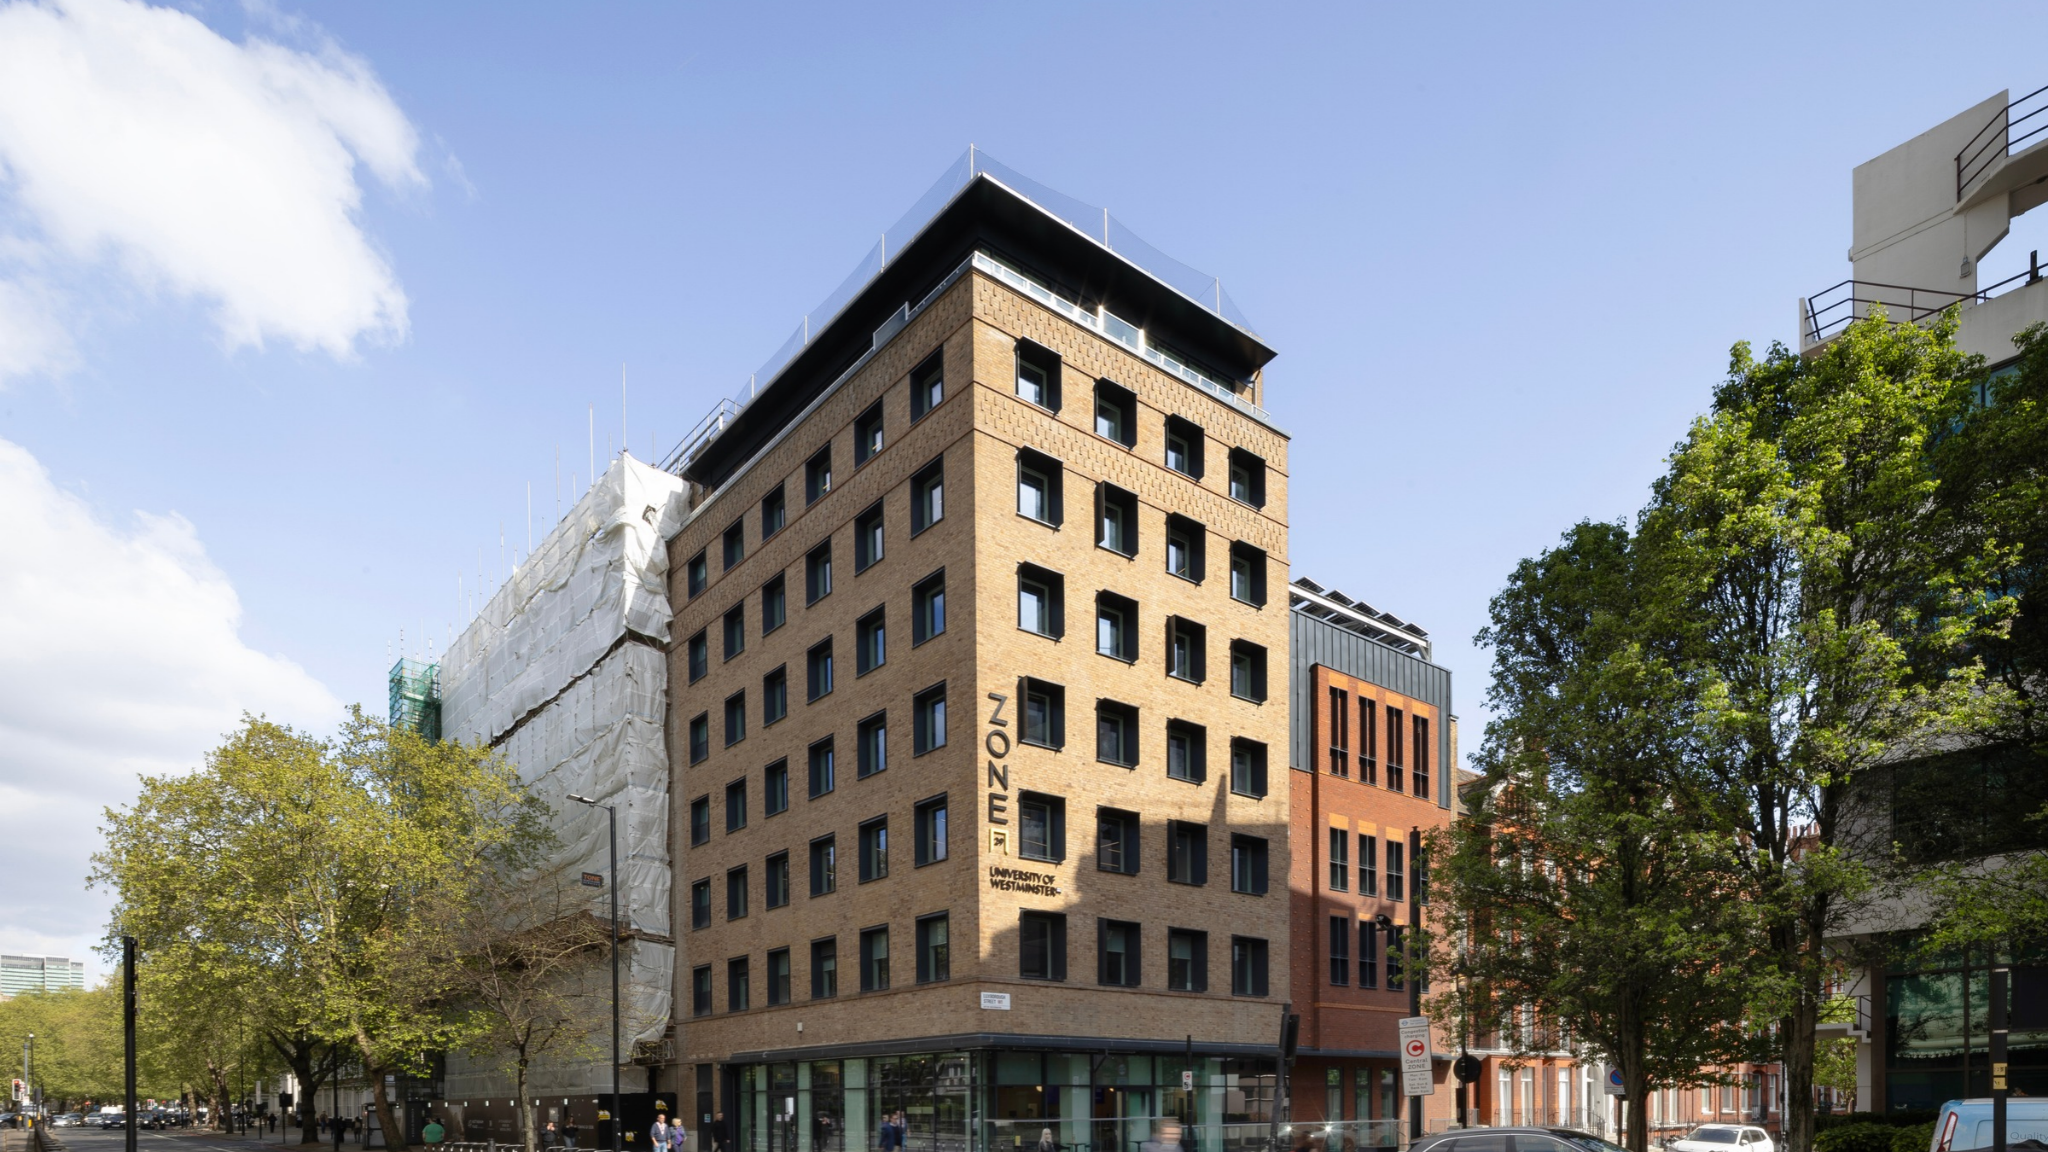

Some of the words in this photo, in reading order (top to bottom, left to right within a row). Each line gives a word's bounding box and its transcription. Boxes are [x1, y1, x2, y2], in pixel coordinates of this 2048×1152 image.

[986, 692, 1010, 825] ZONE
[989, 866, 1043, 883] UNIVERSITY
[1042, 874, 1056, 885] OF
[989, 878, 1056, 898] WESTMINSTER
